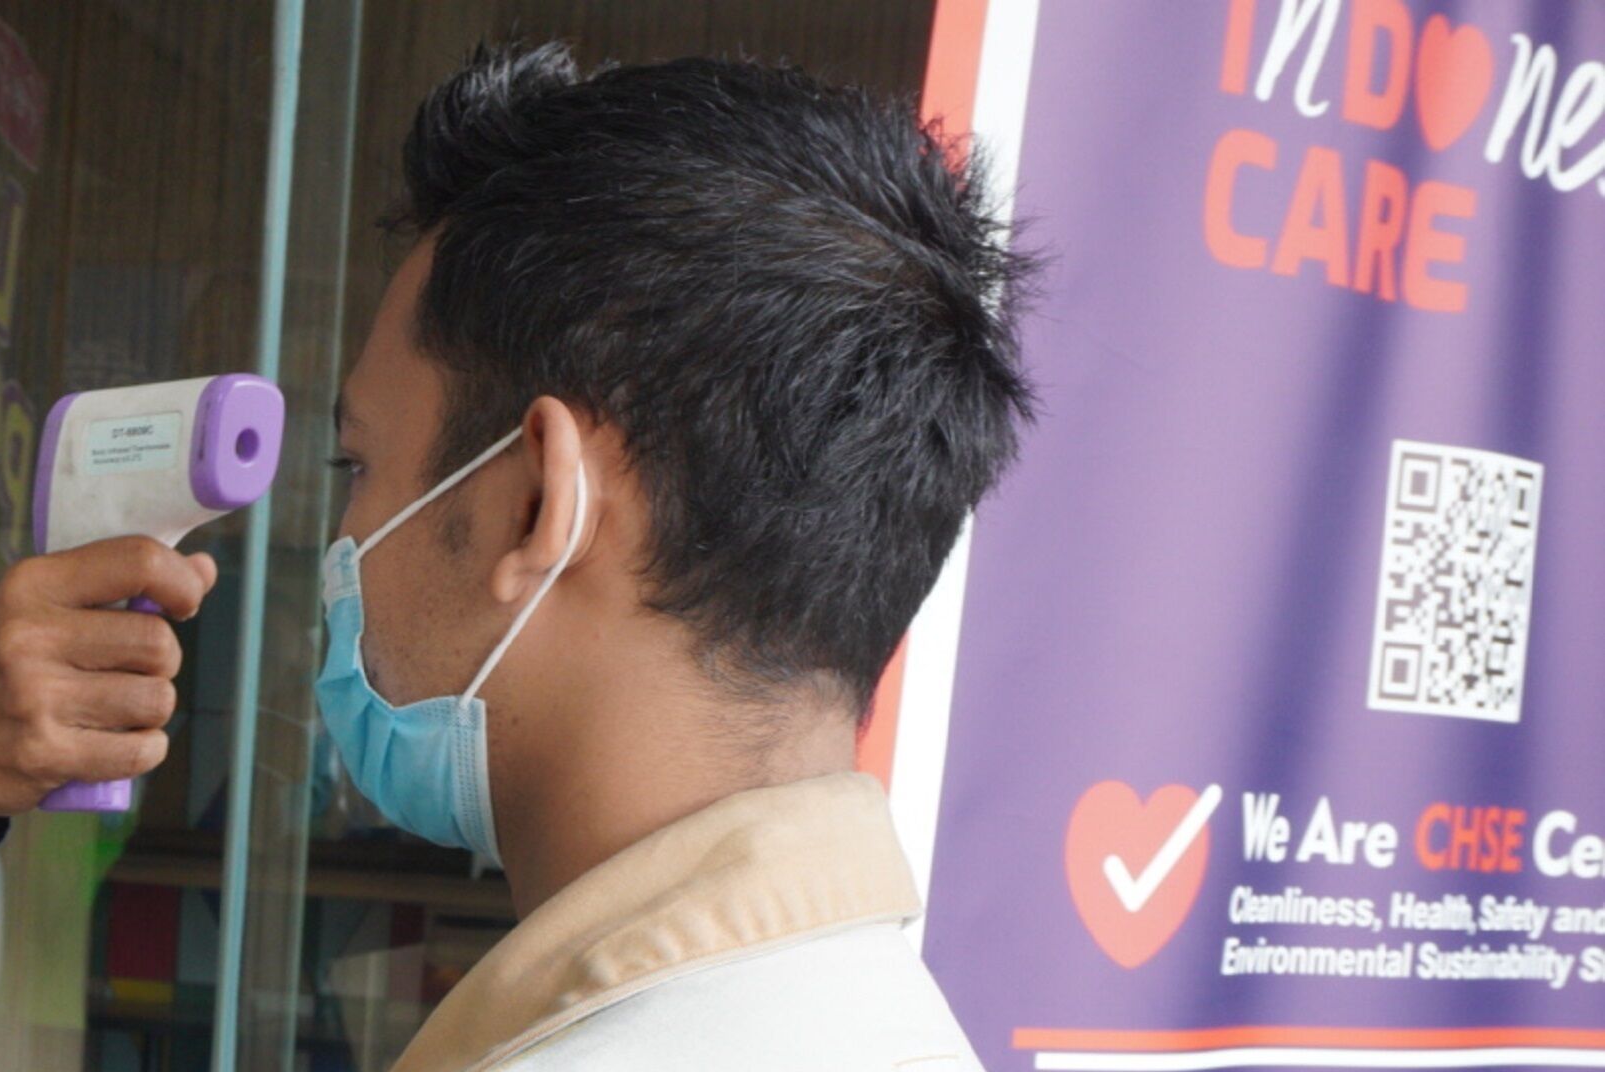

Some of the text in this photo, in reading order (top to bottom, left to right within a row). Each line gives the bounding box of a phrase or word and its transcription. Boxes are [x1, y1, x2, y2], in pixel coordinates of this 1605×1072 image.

[1203, 127, 1479, 314] CARE
[1241, 791, 1605, 879] We Are CHSE Ce
[1229, 885, 1383, 933] Cleanliness,
[1389, 891, 1477, 936] Health,
[1478, 894, 1551, 940] Safety
[1220, 936, 1413, 979] Environmental
[1416, 941, 1575, 990] Sustainability
